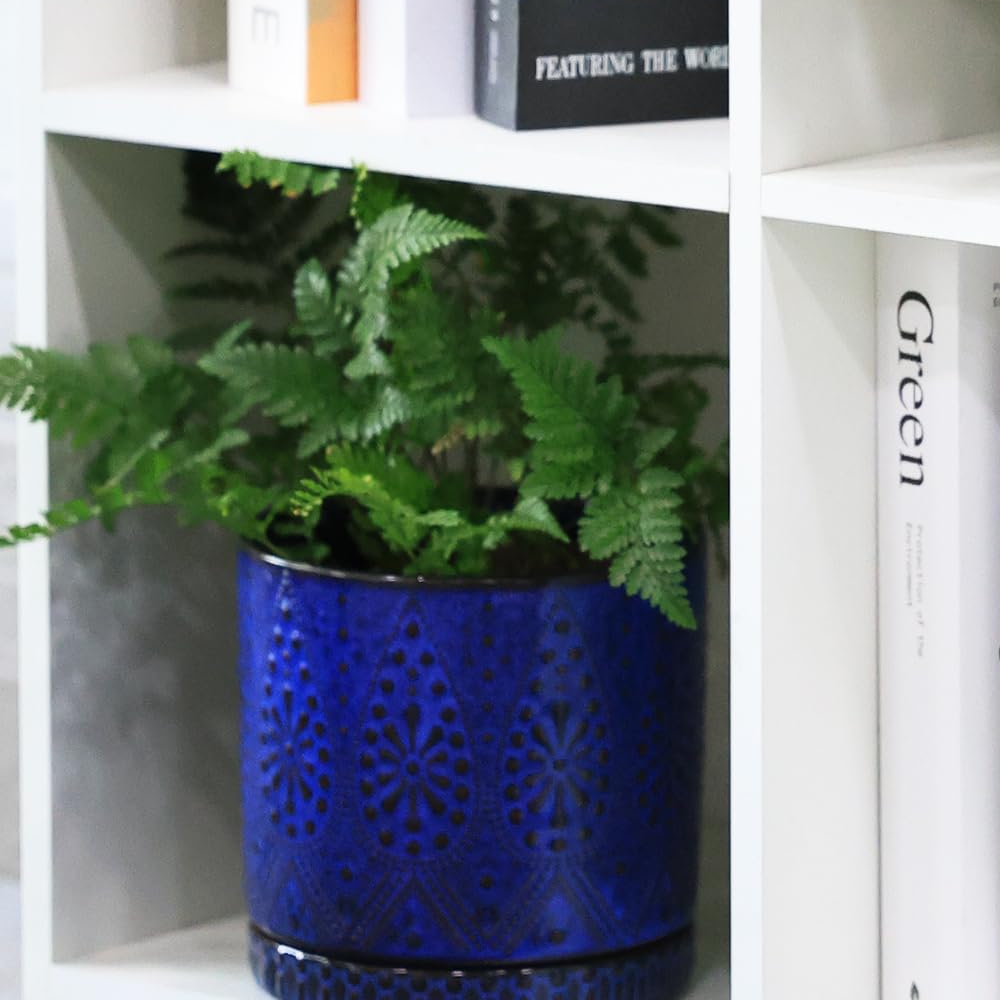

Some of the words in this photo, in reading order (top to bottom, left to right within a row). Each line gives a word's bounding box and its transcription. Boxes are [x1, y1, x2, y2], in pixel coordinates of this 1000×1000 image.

[534, 51, 636, 81] FEATURING
[640, 47, 679, 75] THE
[896, 289, 935, 487] Green
